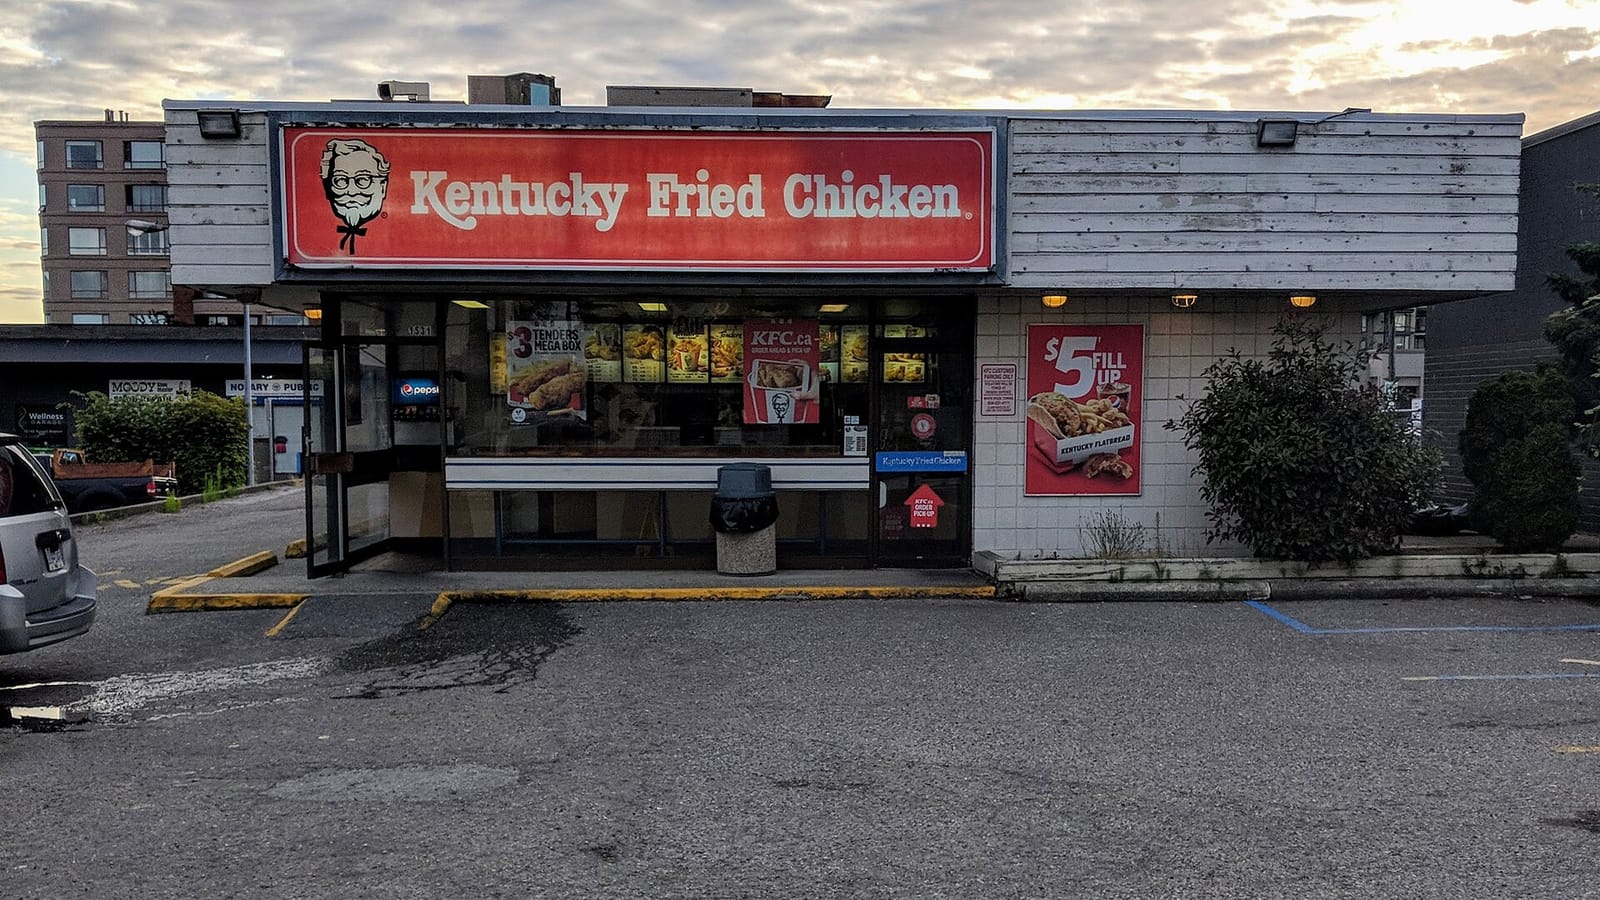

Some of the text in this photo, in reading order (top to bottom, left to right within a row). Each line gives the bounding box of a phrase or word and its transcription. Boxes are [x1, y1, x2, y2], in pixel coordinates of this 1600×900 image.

[409, 169, 961, 232] Kentucky Fried Chicken
[408, 325, 432, 336] 1531
[533, 329, 579, 340] TENDERS
[751, 331, 813, 346] KFC.ca
[534, 341, 582, 351] MEGA BOX
[1044, 336, 1127, 399] $5 FILL
[1097, 369, 1122, 384] UP
[112, 382, 156, 392] MOODY
[230, 383, 269, 391] NOARY
[413, 386, 440, 396] pepsi
[29, 412, 65, 420] Wellness
[1060, 434, 1131, 455] KENTUCKY FLATBREAD
[882, 457, 915, 467] Kentucky
[934, 457, 962, 465] Chicken
